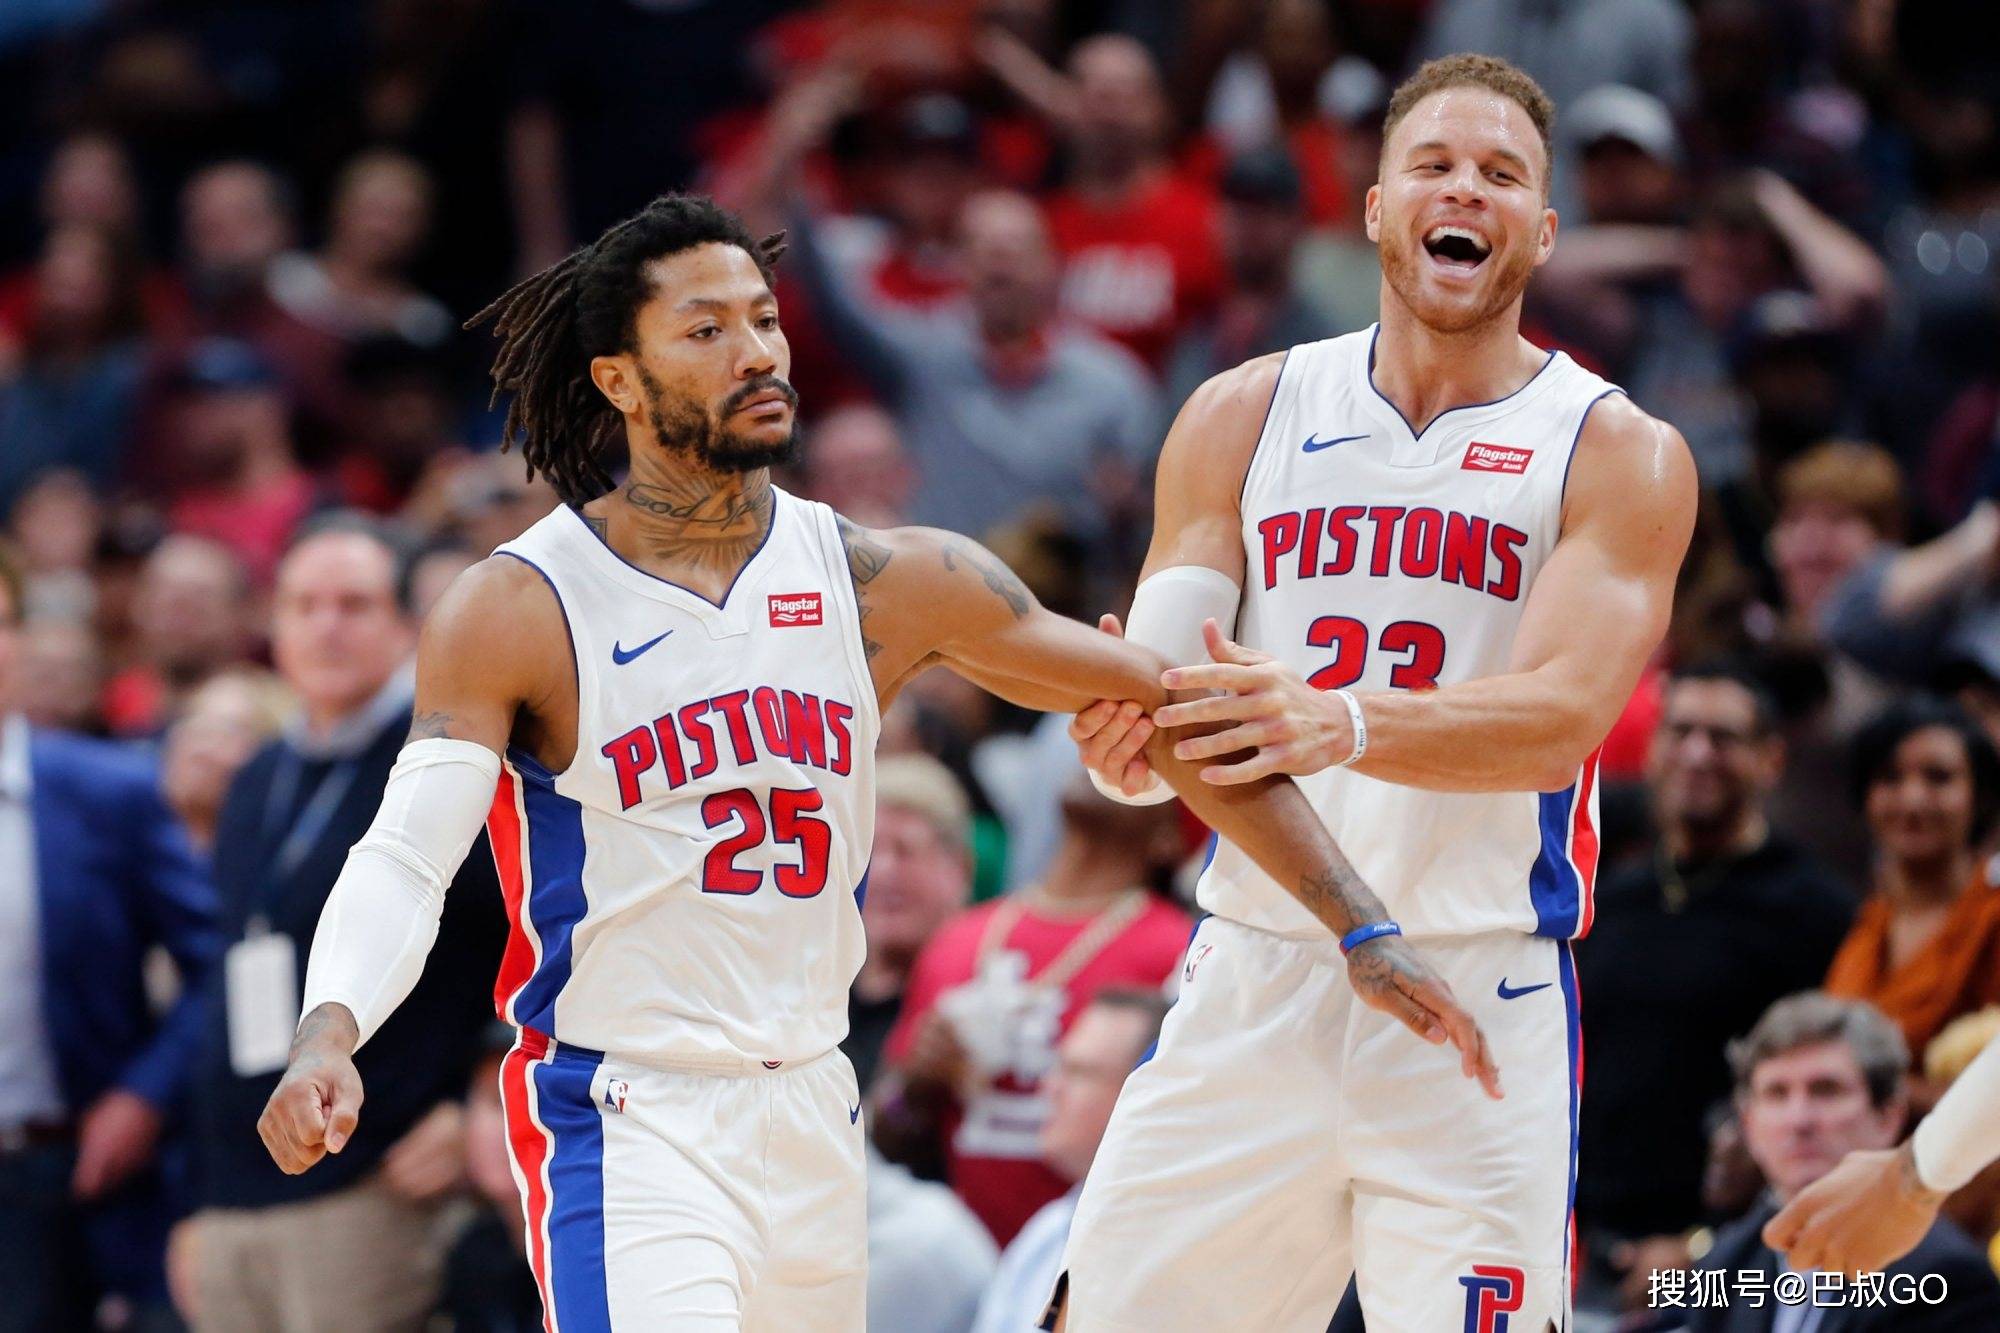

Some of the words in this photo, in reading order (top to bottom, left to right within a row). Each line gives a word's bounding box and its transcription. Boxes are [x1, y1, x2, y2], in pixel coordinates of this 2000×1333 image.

[1470, 445, 1529, 462] Flagstar
[1502, 462, 1523, 471] Bank
[1258, 505, 1528, 602] PISTONS
[771, 598, 819, 614] Flagstar
[801, 613, 819, 621] Bank
[1306, 615, 1446, 692] 23
[601, 685, 853, 812] PISTONS
[700, 787, 831, 899] 25
